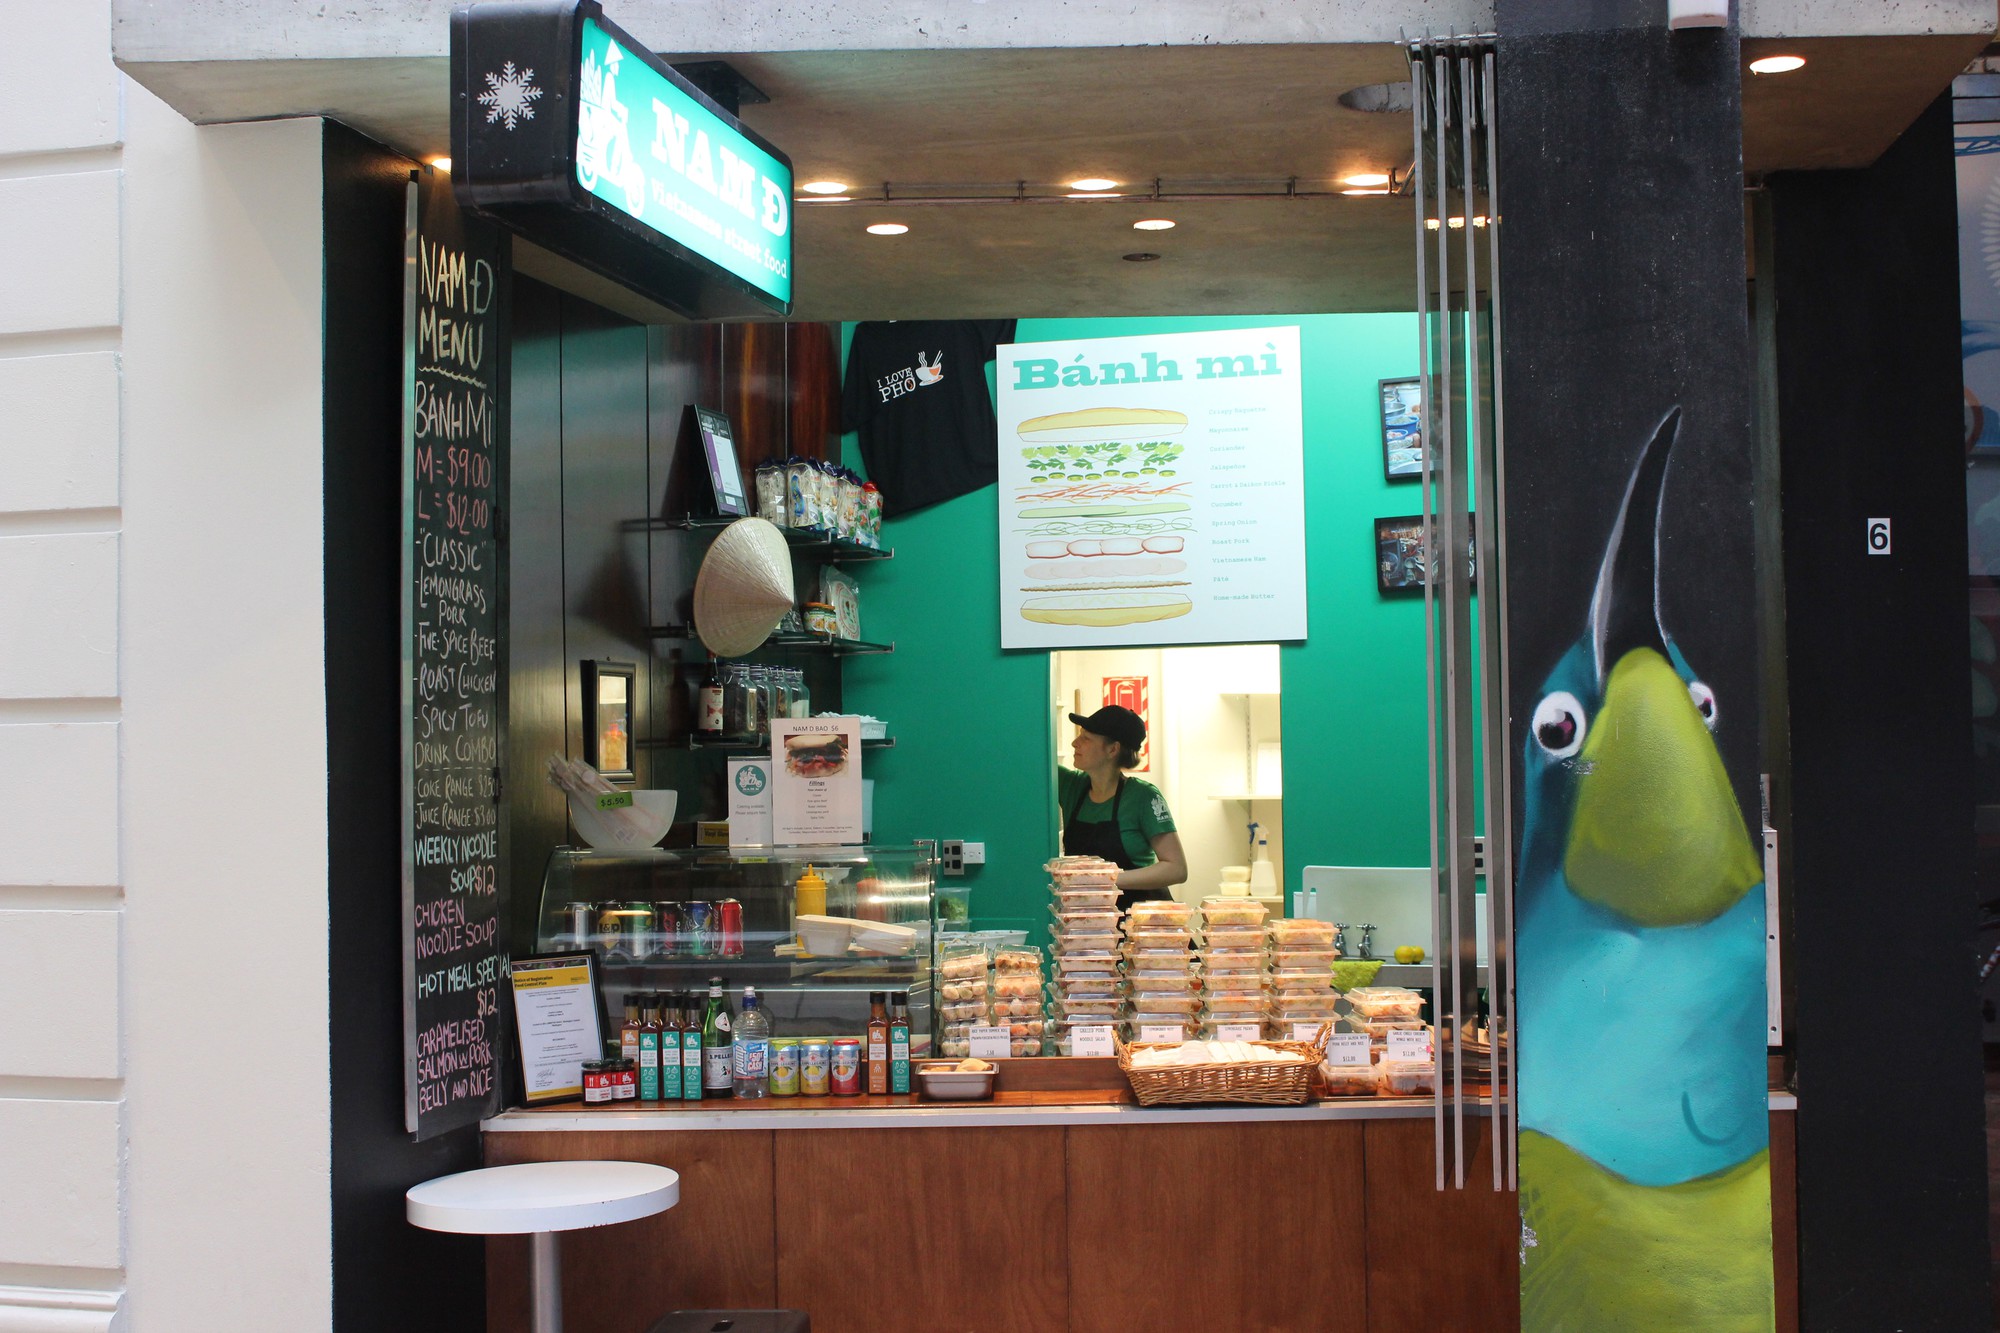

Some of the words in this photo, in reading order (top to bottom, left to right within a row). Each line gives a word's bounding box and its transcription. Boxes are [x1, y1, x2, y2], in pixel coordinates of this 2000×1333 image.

[652, 97, 755, 220] NAM
[724, 228, 762, 264] street
[764, 247, 787, 279] food
[420, 235, 468, 314] NAM
[419, 305, 484, 371] MENU
[877, 379, 882, 388] I
[885, 367, 913, 385] LOVE
[1013, 352, 1183, 390] Bánh
[1196, 342, 1282, 379] mì
[1870, 523, 1888, 550] 6
[439, 600, 467, 628] PORK
[470, 627, 496, 666] BEEF
[458, 662, 497, 699] CHICKEN
[459, 702, 489, 731] TOFU
[415, 741, 450, 769] DRINK
[455, 734, 496, 763] COMBO
[417, 778, 441, 798] COKE
[445, 774, 474, 804] RANGE
[416, 803, 440, 829] JUICE
[442, 802, 471, 831] RANGE
[415, 835, 460, 867] WEEKLY
[461, 830, 497, 864] NOODLE
[450, 866, 475, 894] SOUP
[475, 862, 496, 895] $12
[415, 897, 465, 928] CHICKEN
[417, 922, 462, 960] NOODLE
[466, 916, 497, 948] SOUP
[418, 969, 445, 999] HOT
[448, 964, 476, 993] MEAL
[477, 952, 512, 986] SPECIAL
[477, 987, 498, 1018] $12
[416, 1018, 486, 1059] CARAMELISED
[418, 1054, 457, 1084] SALMON
[469, 1042, 493, 1067] PORK
[419, 1076, 449, 1107] BELLY
[452, 1079, 468, 1101] AND
[470, 1067, 493, 1097] RICE
